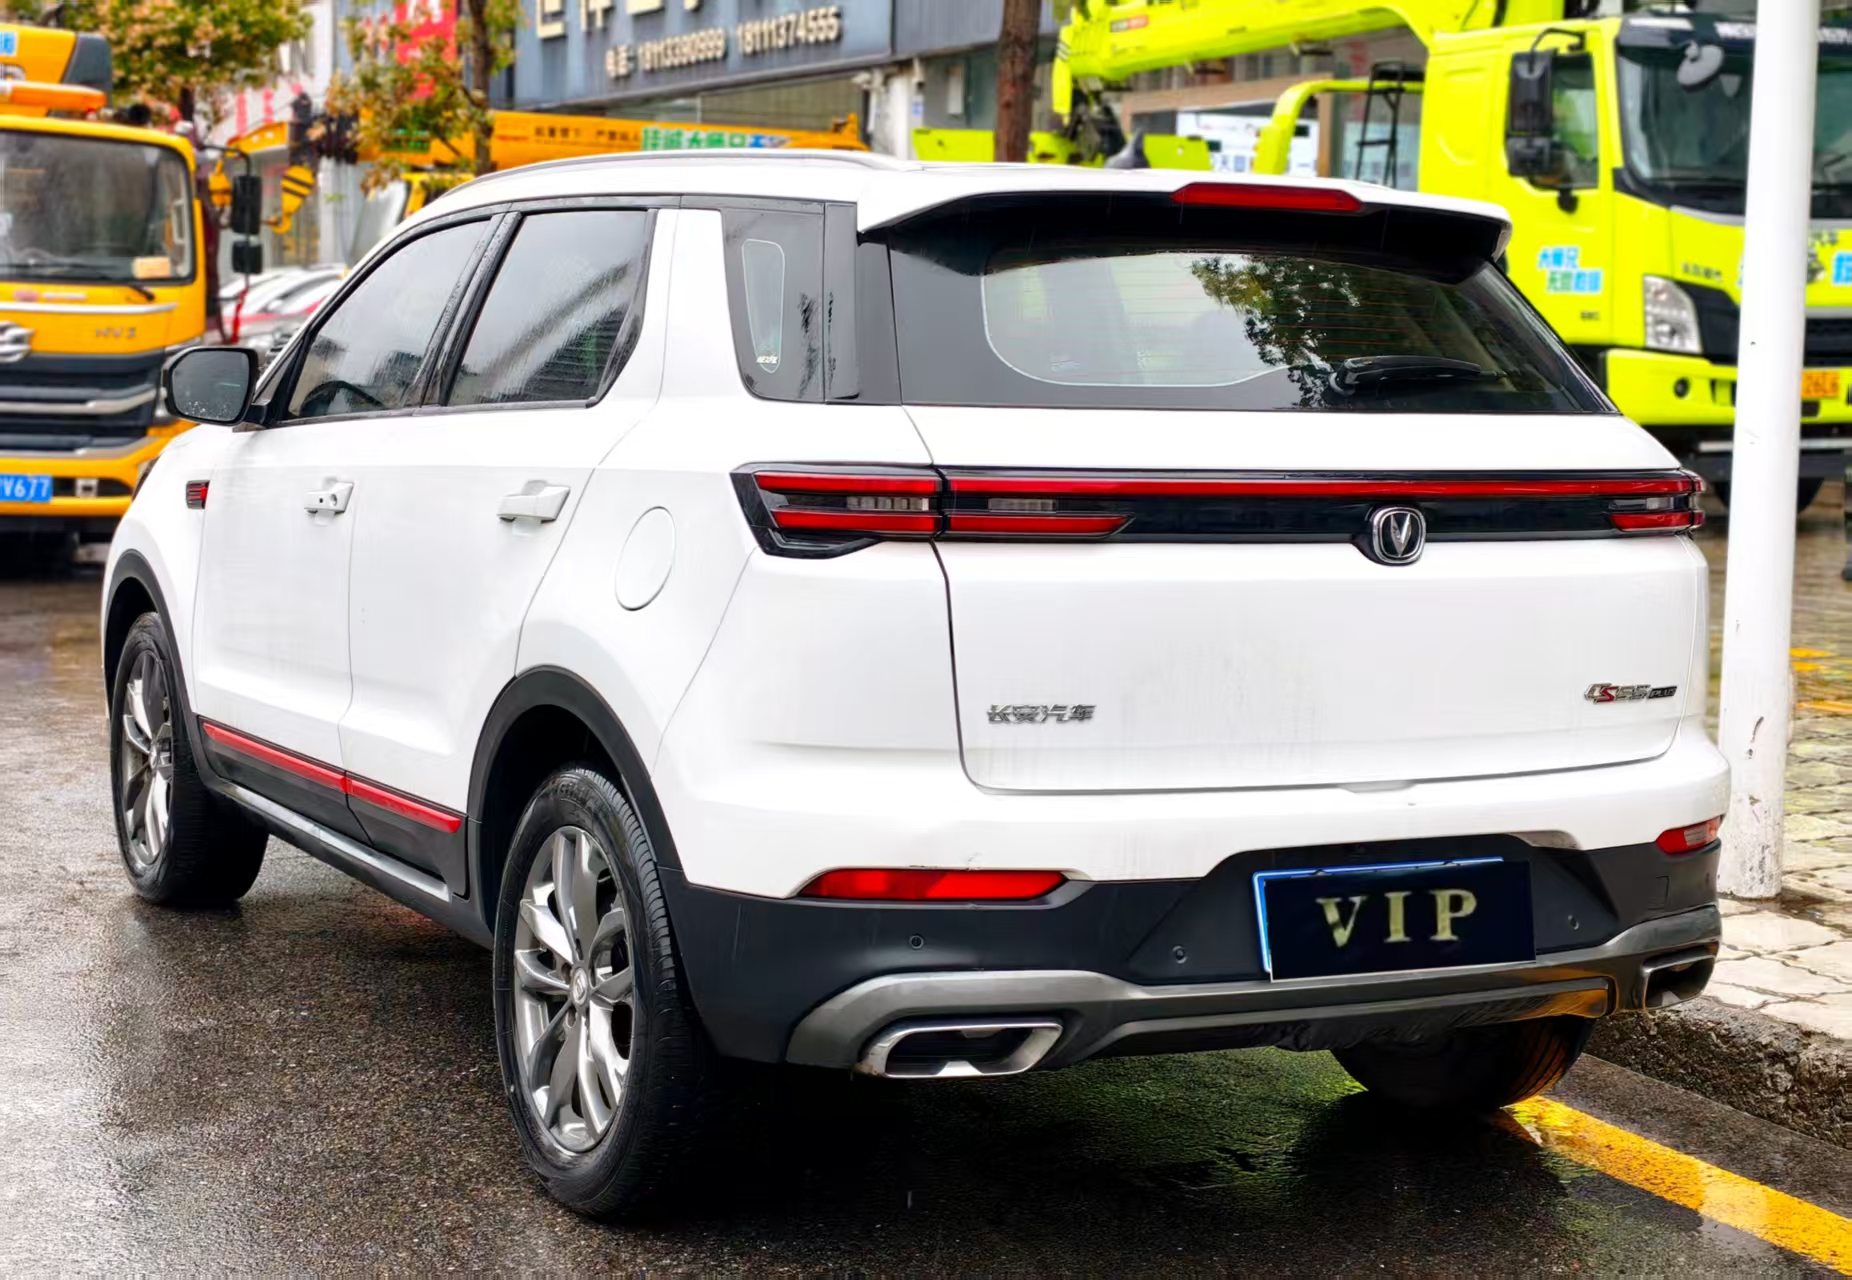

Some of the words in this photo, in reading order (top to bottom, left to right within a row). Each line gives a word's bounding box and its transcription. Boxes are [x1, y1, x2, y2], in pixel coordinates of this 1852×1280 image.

[987, 703, 1097, 724] 长安汽车
[1315, 888, 1477, 948] VIP
